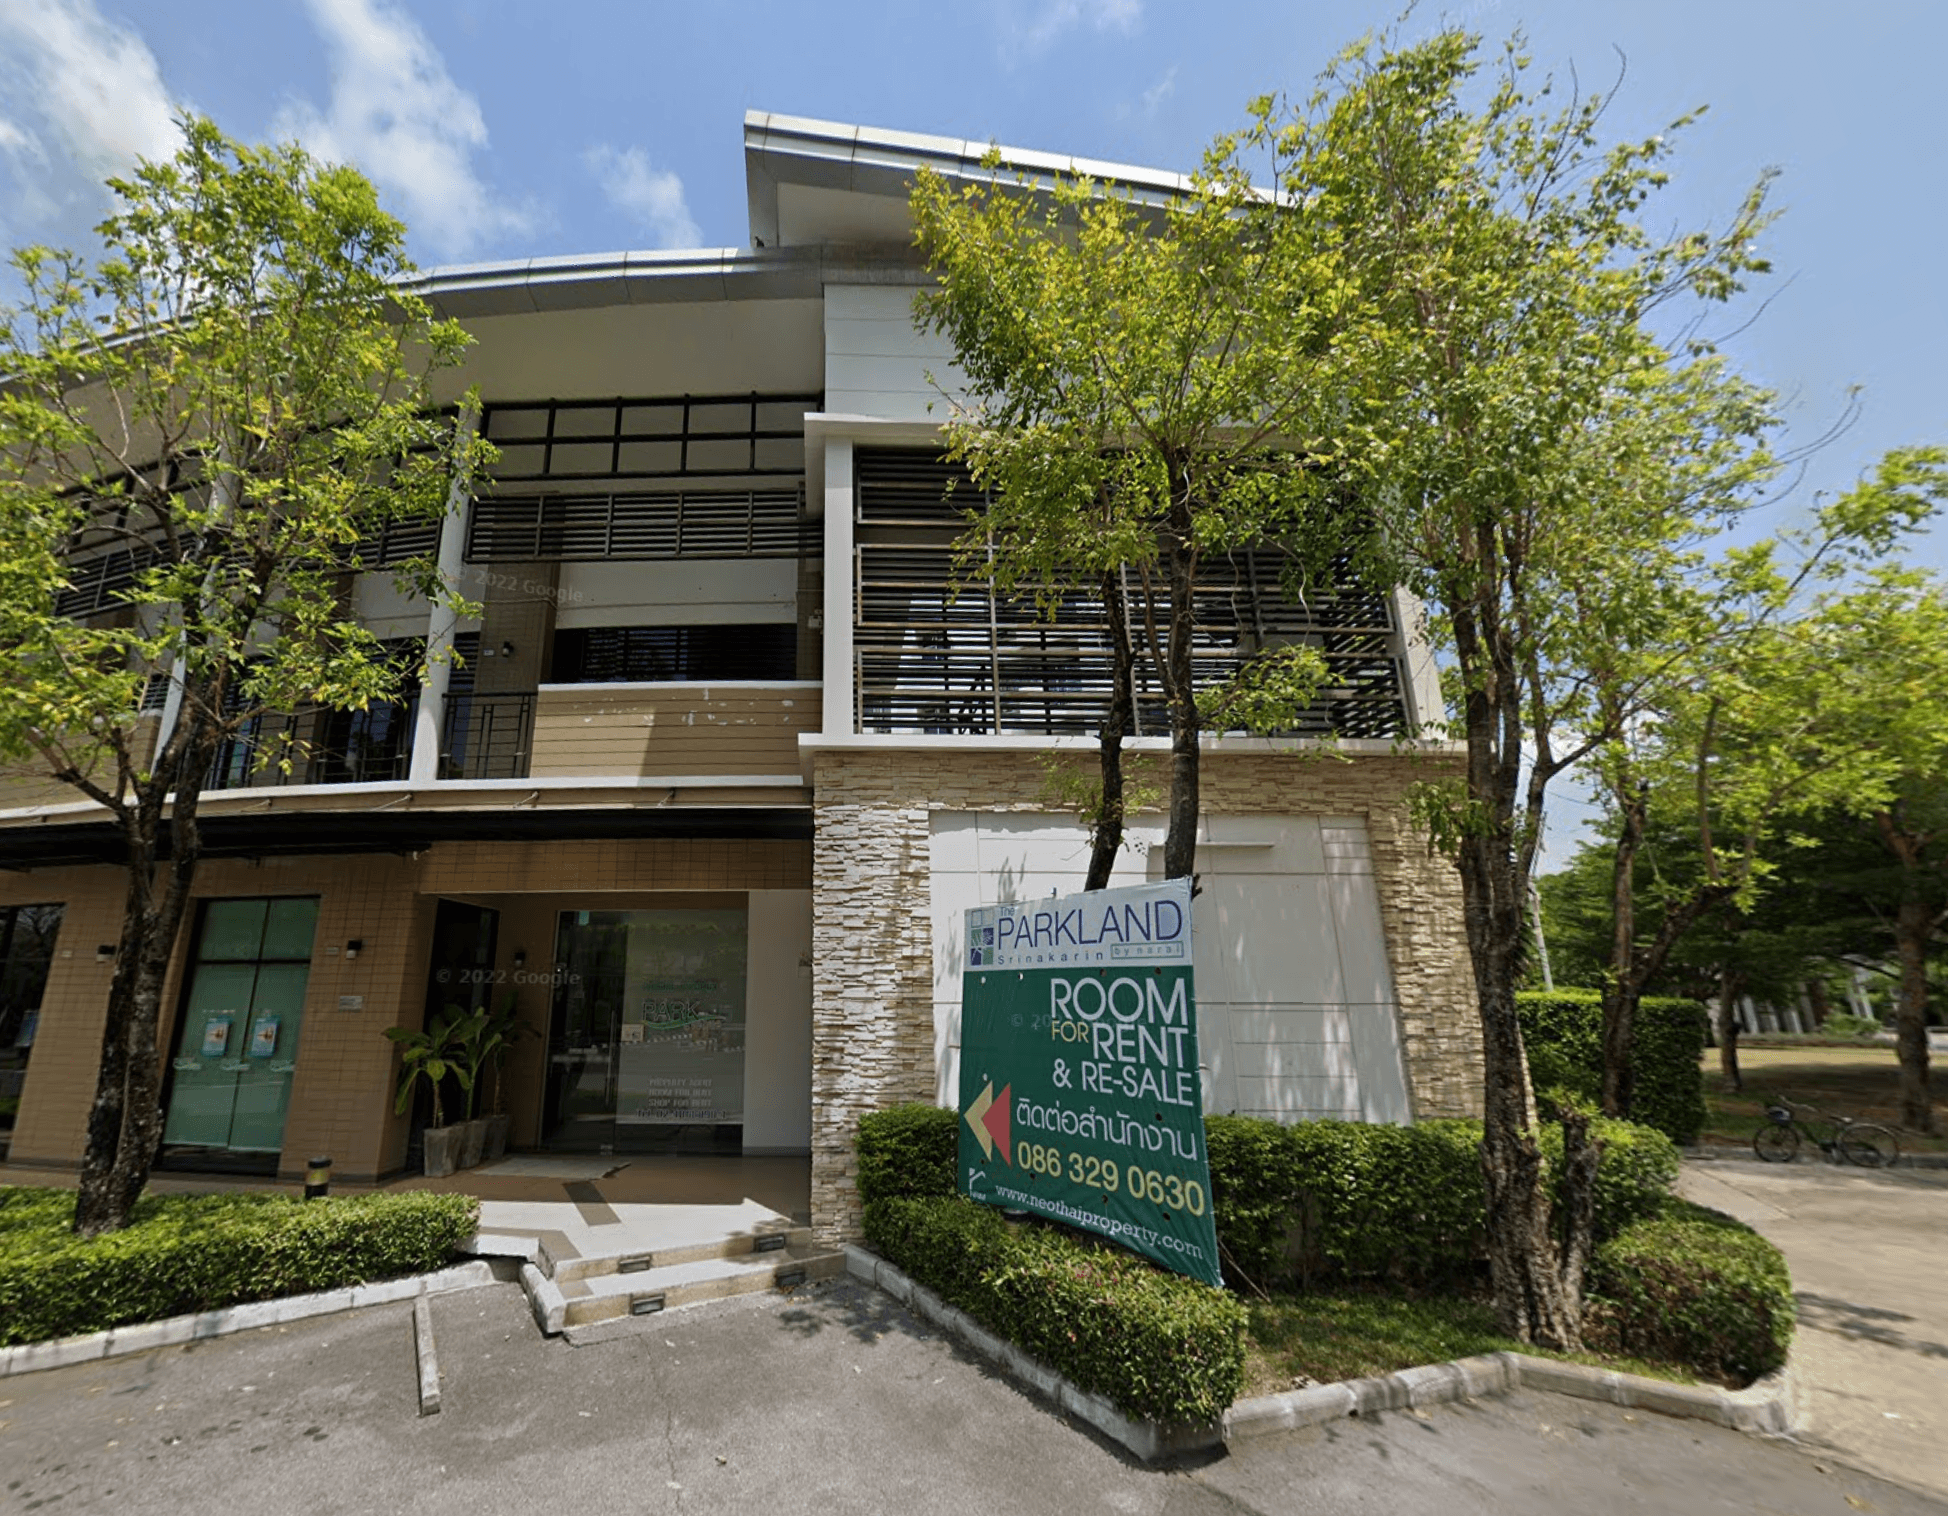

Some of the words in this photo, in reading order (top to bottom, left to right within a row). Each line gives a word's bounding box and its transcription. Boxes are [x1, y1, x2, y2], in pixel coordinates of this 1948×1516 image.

[998, 899, 1183, 950] PARKLAND
[997, 950, 1104, 965] Srinakarin
[642, 998, 701, 1021] PARK
[1050, 977, 1189, 1026] ROOM
[1051, 1020, 1090, 1044] FOR
[1092, 1022, 1189, 1069] RENT
[1052, 1058, 1073, 1090] &
[1081, 1060, 1195, 1107] RE-SALE
[1016, 1097, 1198, 1161] ติดต่อสำนักงาน
[1017, 1141, 1062, 1178] 086
[1068, 1152, 1119, 1192] 329
[1127, 1164, 1205, 1217] 0630
[995, 1183, 1204, 1260] www.neothaiproperty.com
